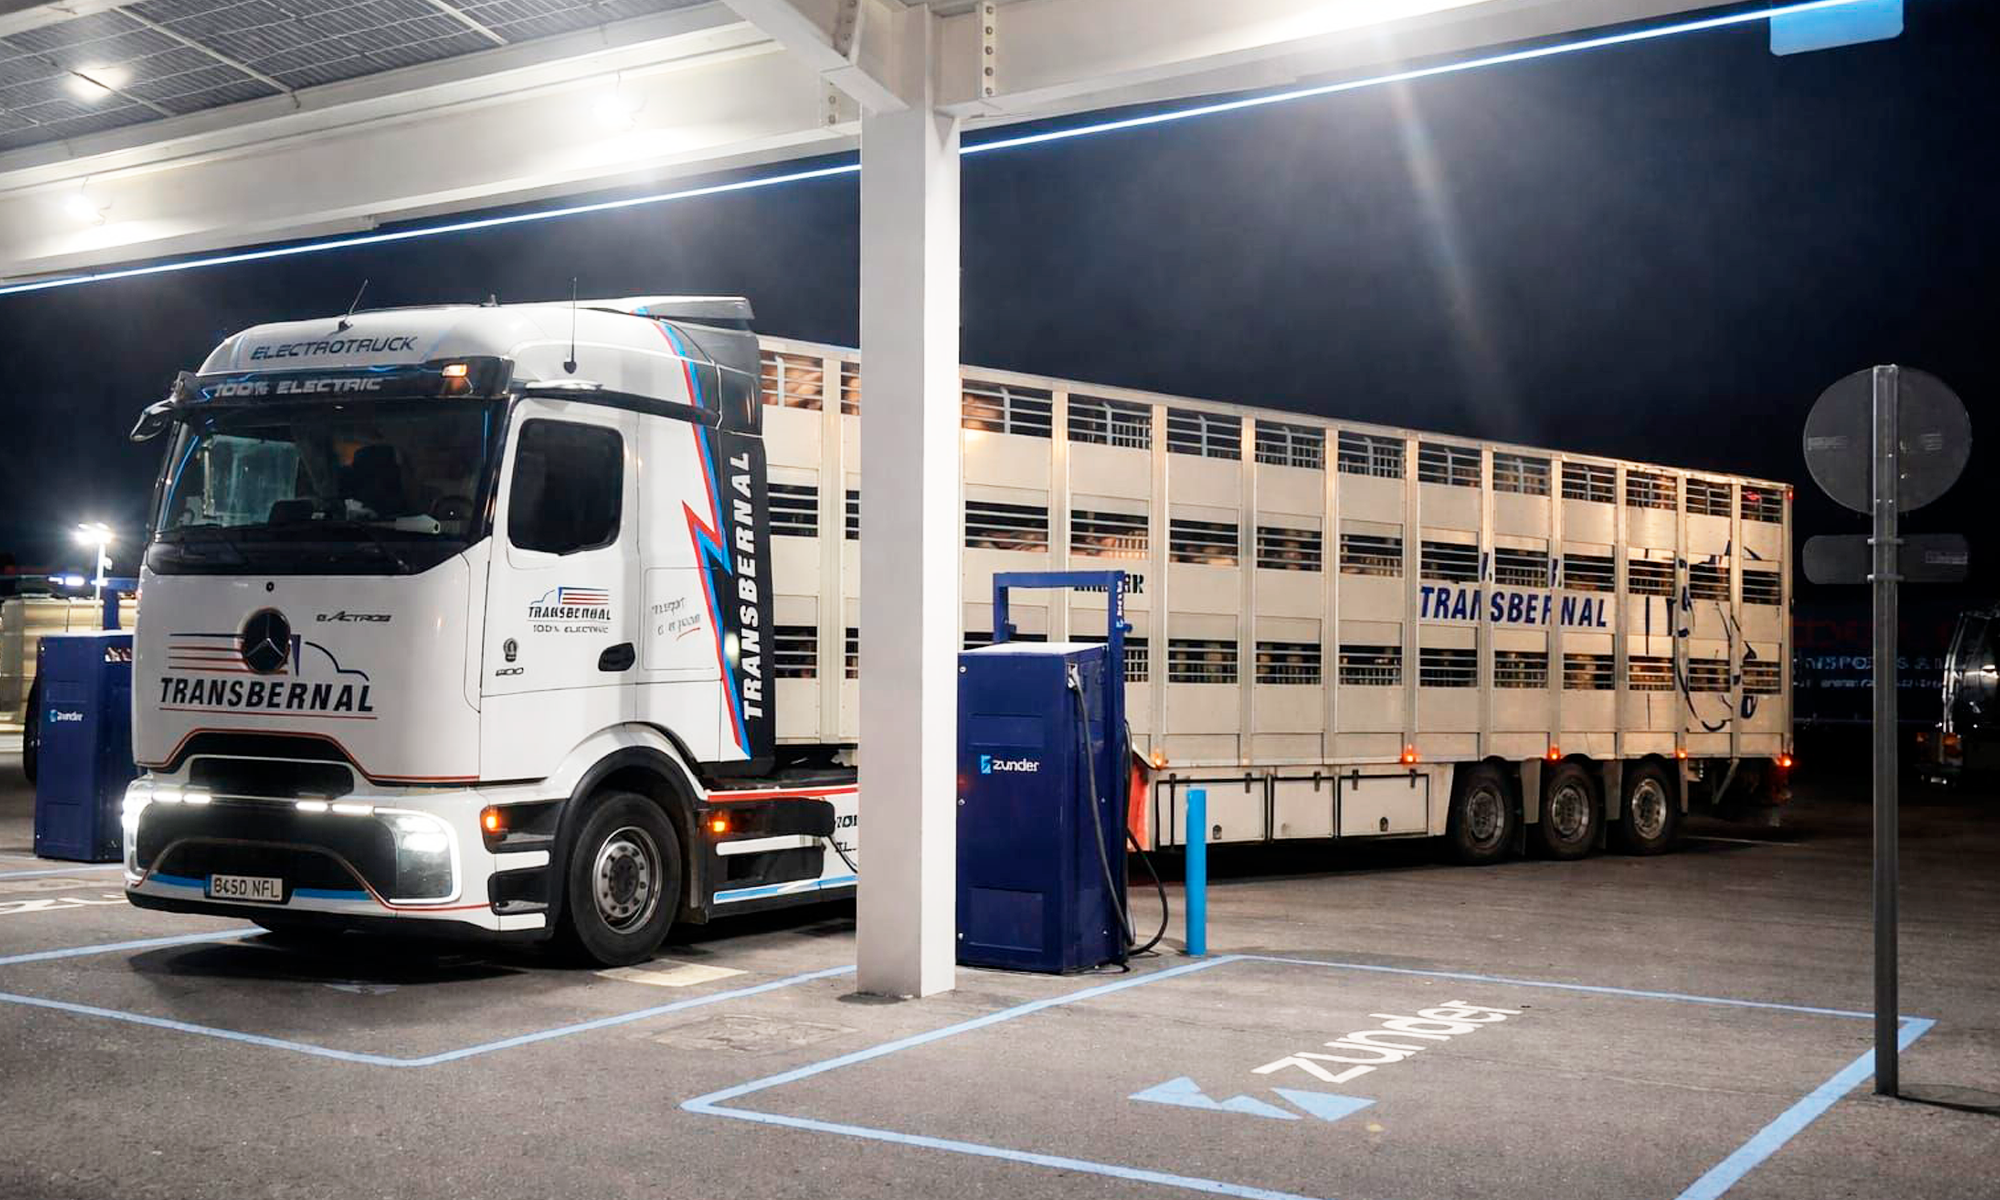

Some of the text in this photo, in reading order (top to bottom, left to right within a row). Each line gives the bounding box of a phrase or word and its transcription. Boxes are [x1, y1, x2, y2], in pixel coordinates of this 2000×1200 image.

[251, 336, 417, 361] ELECTROTRUCK
[214, 377, 384, 398] 100% ELECTRIC
[730, 452, 763, 720] TRANSBERNAL
[528, 606, 611, 621] TRANSBERNAL
[160, 677, 373, 712] TRANSBERNAL
[992, 758, 1040, 772] zunder
[252, 881, 280, 898] NFL
[1250, 1000, 1524, 1084] zunder
